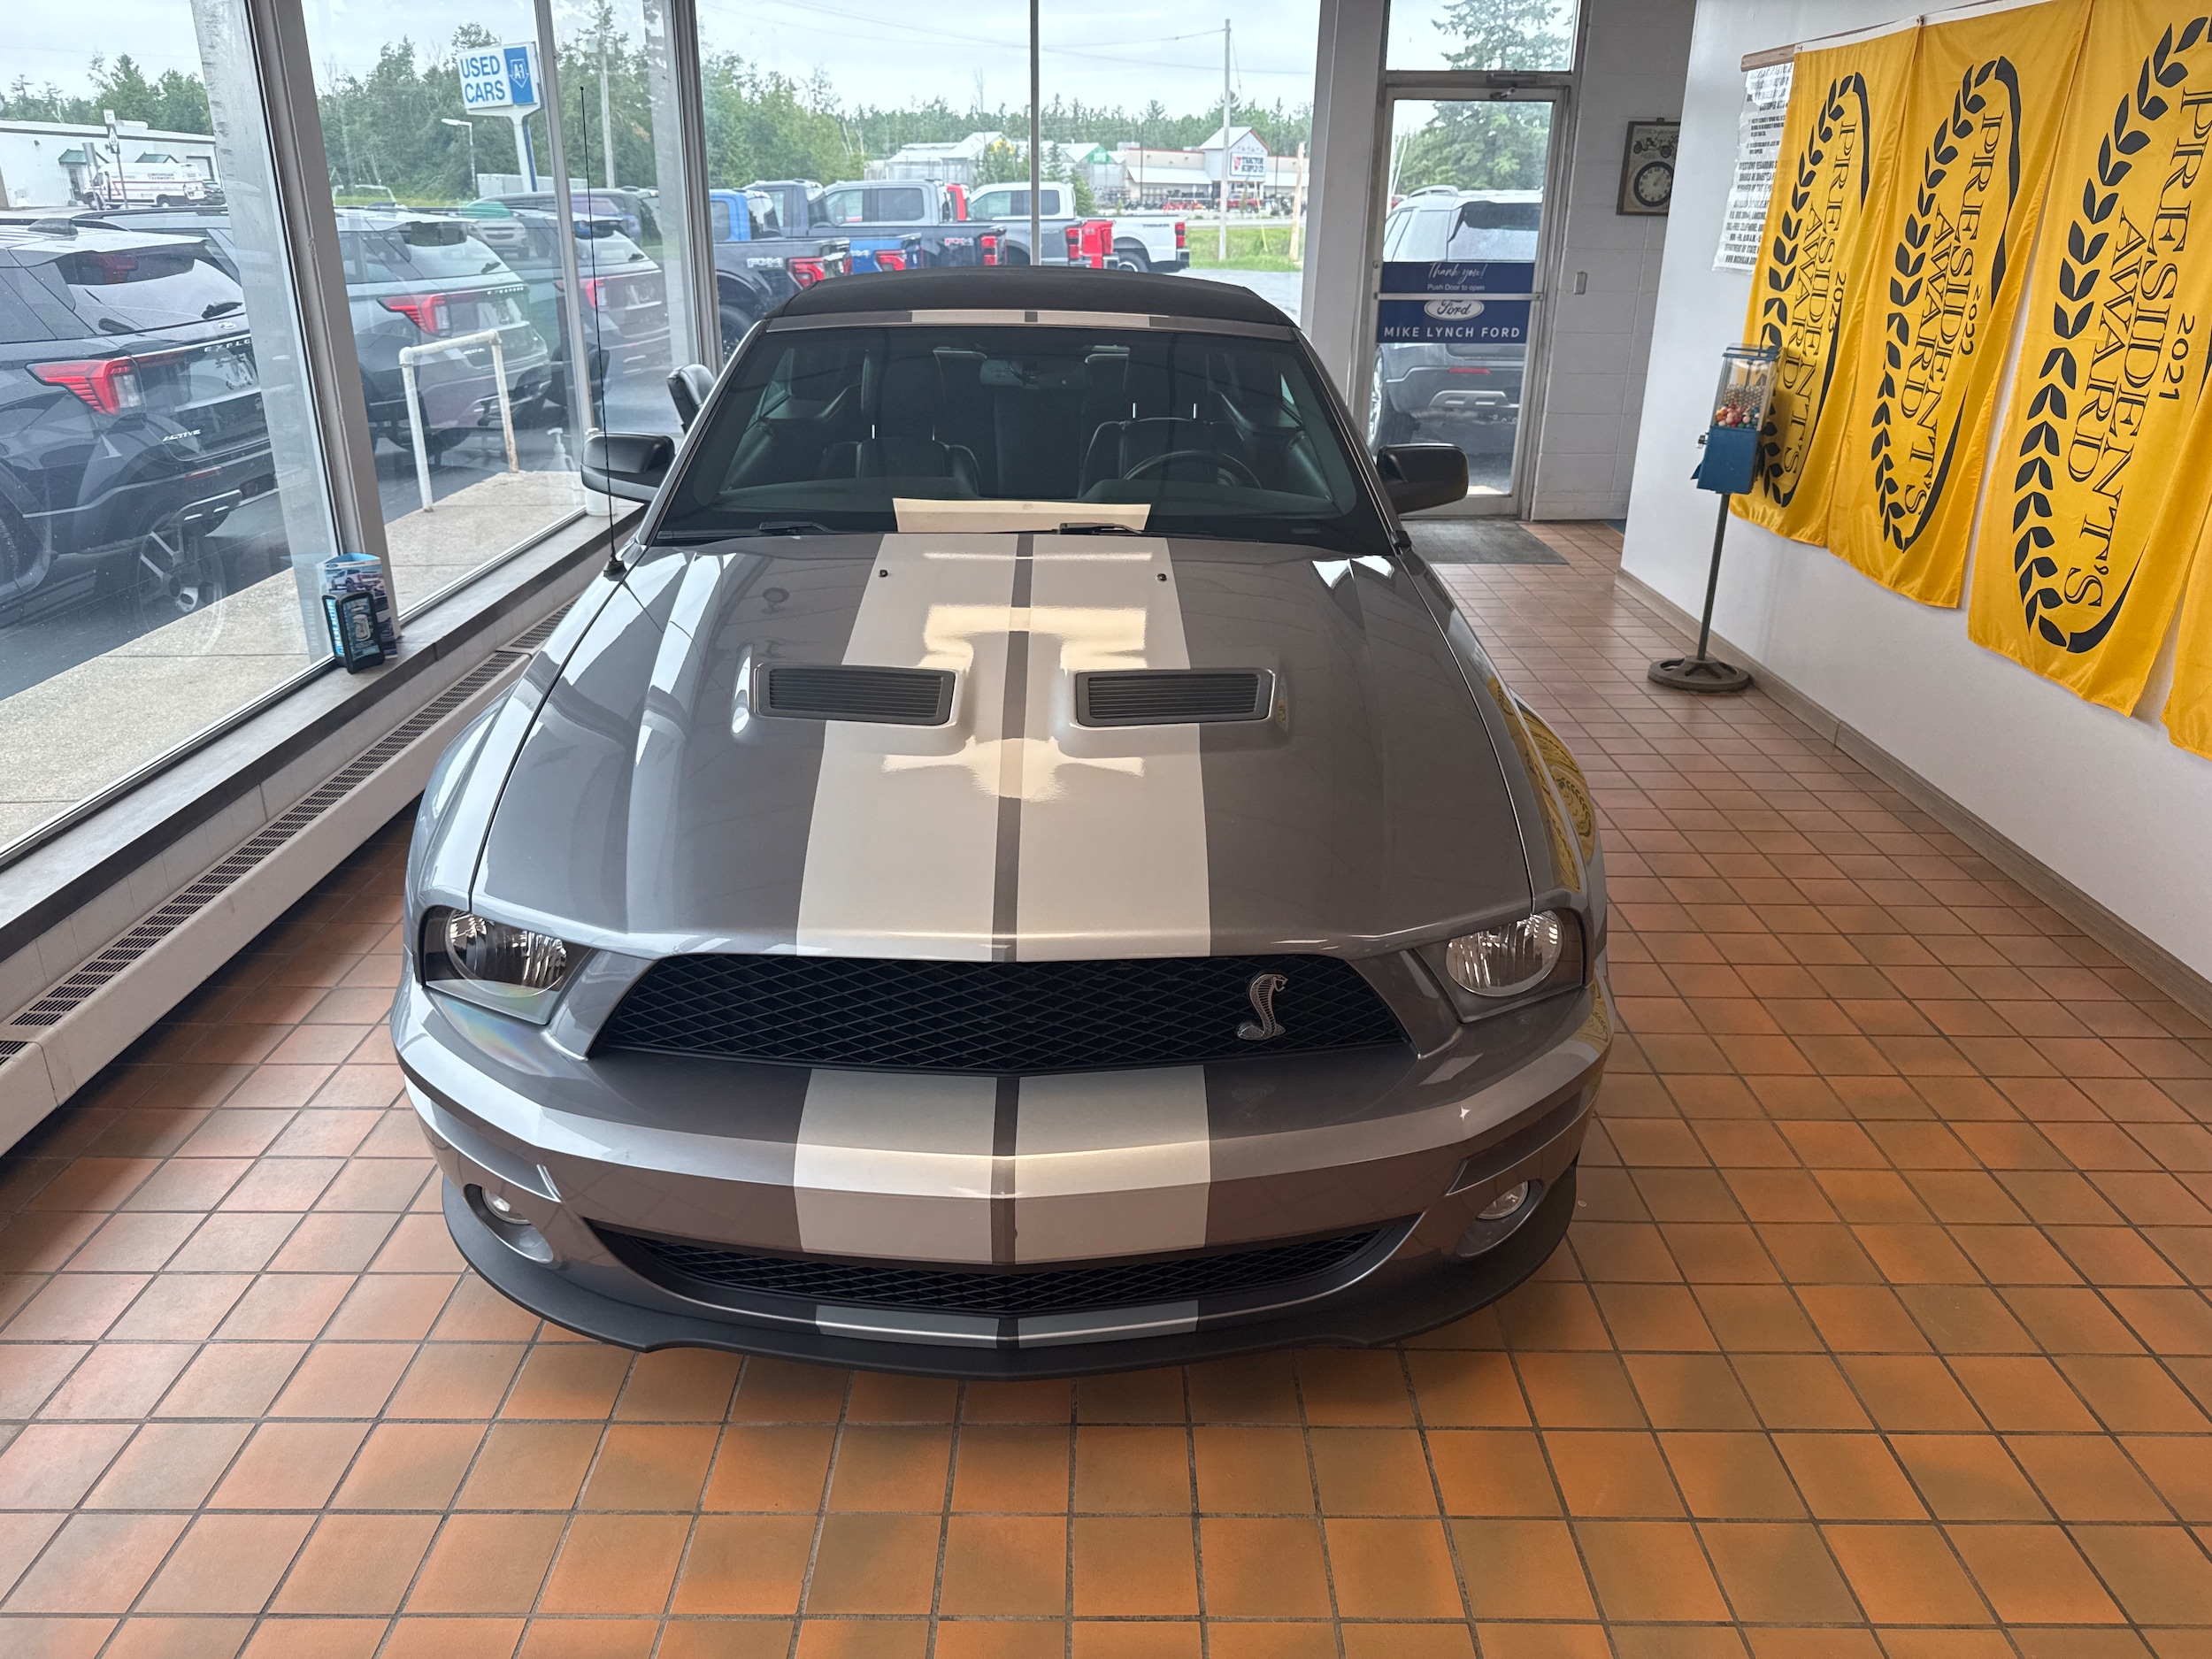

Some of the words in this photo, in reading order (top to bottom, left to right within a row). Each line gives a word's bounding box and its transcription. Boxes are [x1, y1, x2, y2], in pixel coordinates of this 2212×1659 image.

[460, 55, 501, 79] USED
[465, 80, 505, 104] CARS
[1428, 262, 1459, 279] Thank
[1456, 263, 1488, 285] you!
[1436, 299, 1472, 316] Ford
[1783, 203, 1824, 391] AWARD
[1784, 119, 1857, 476] PRESIDENT'S
[1828, 271, 1847, 334] 2023
[1384, 326, 1419, 338] MIKE
[1426, 326, 1475, 338] LYNCH
[1481, 327, 1520, 338] FORD
[1901, 203, 1955, 419] AWARD
[1904, 111, 2004, 518] PRESIDENT'S
[1960, 285, 1984, 356] 2022
[2068, 204, 2147, 486] AWARD
[2158, 312, 2196, 402] 2021
